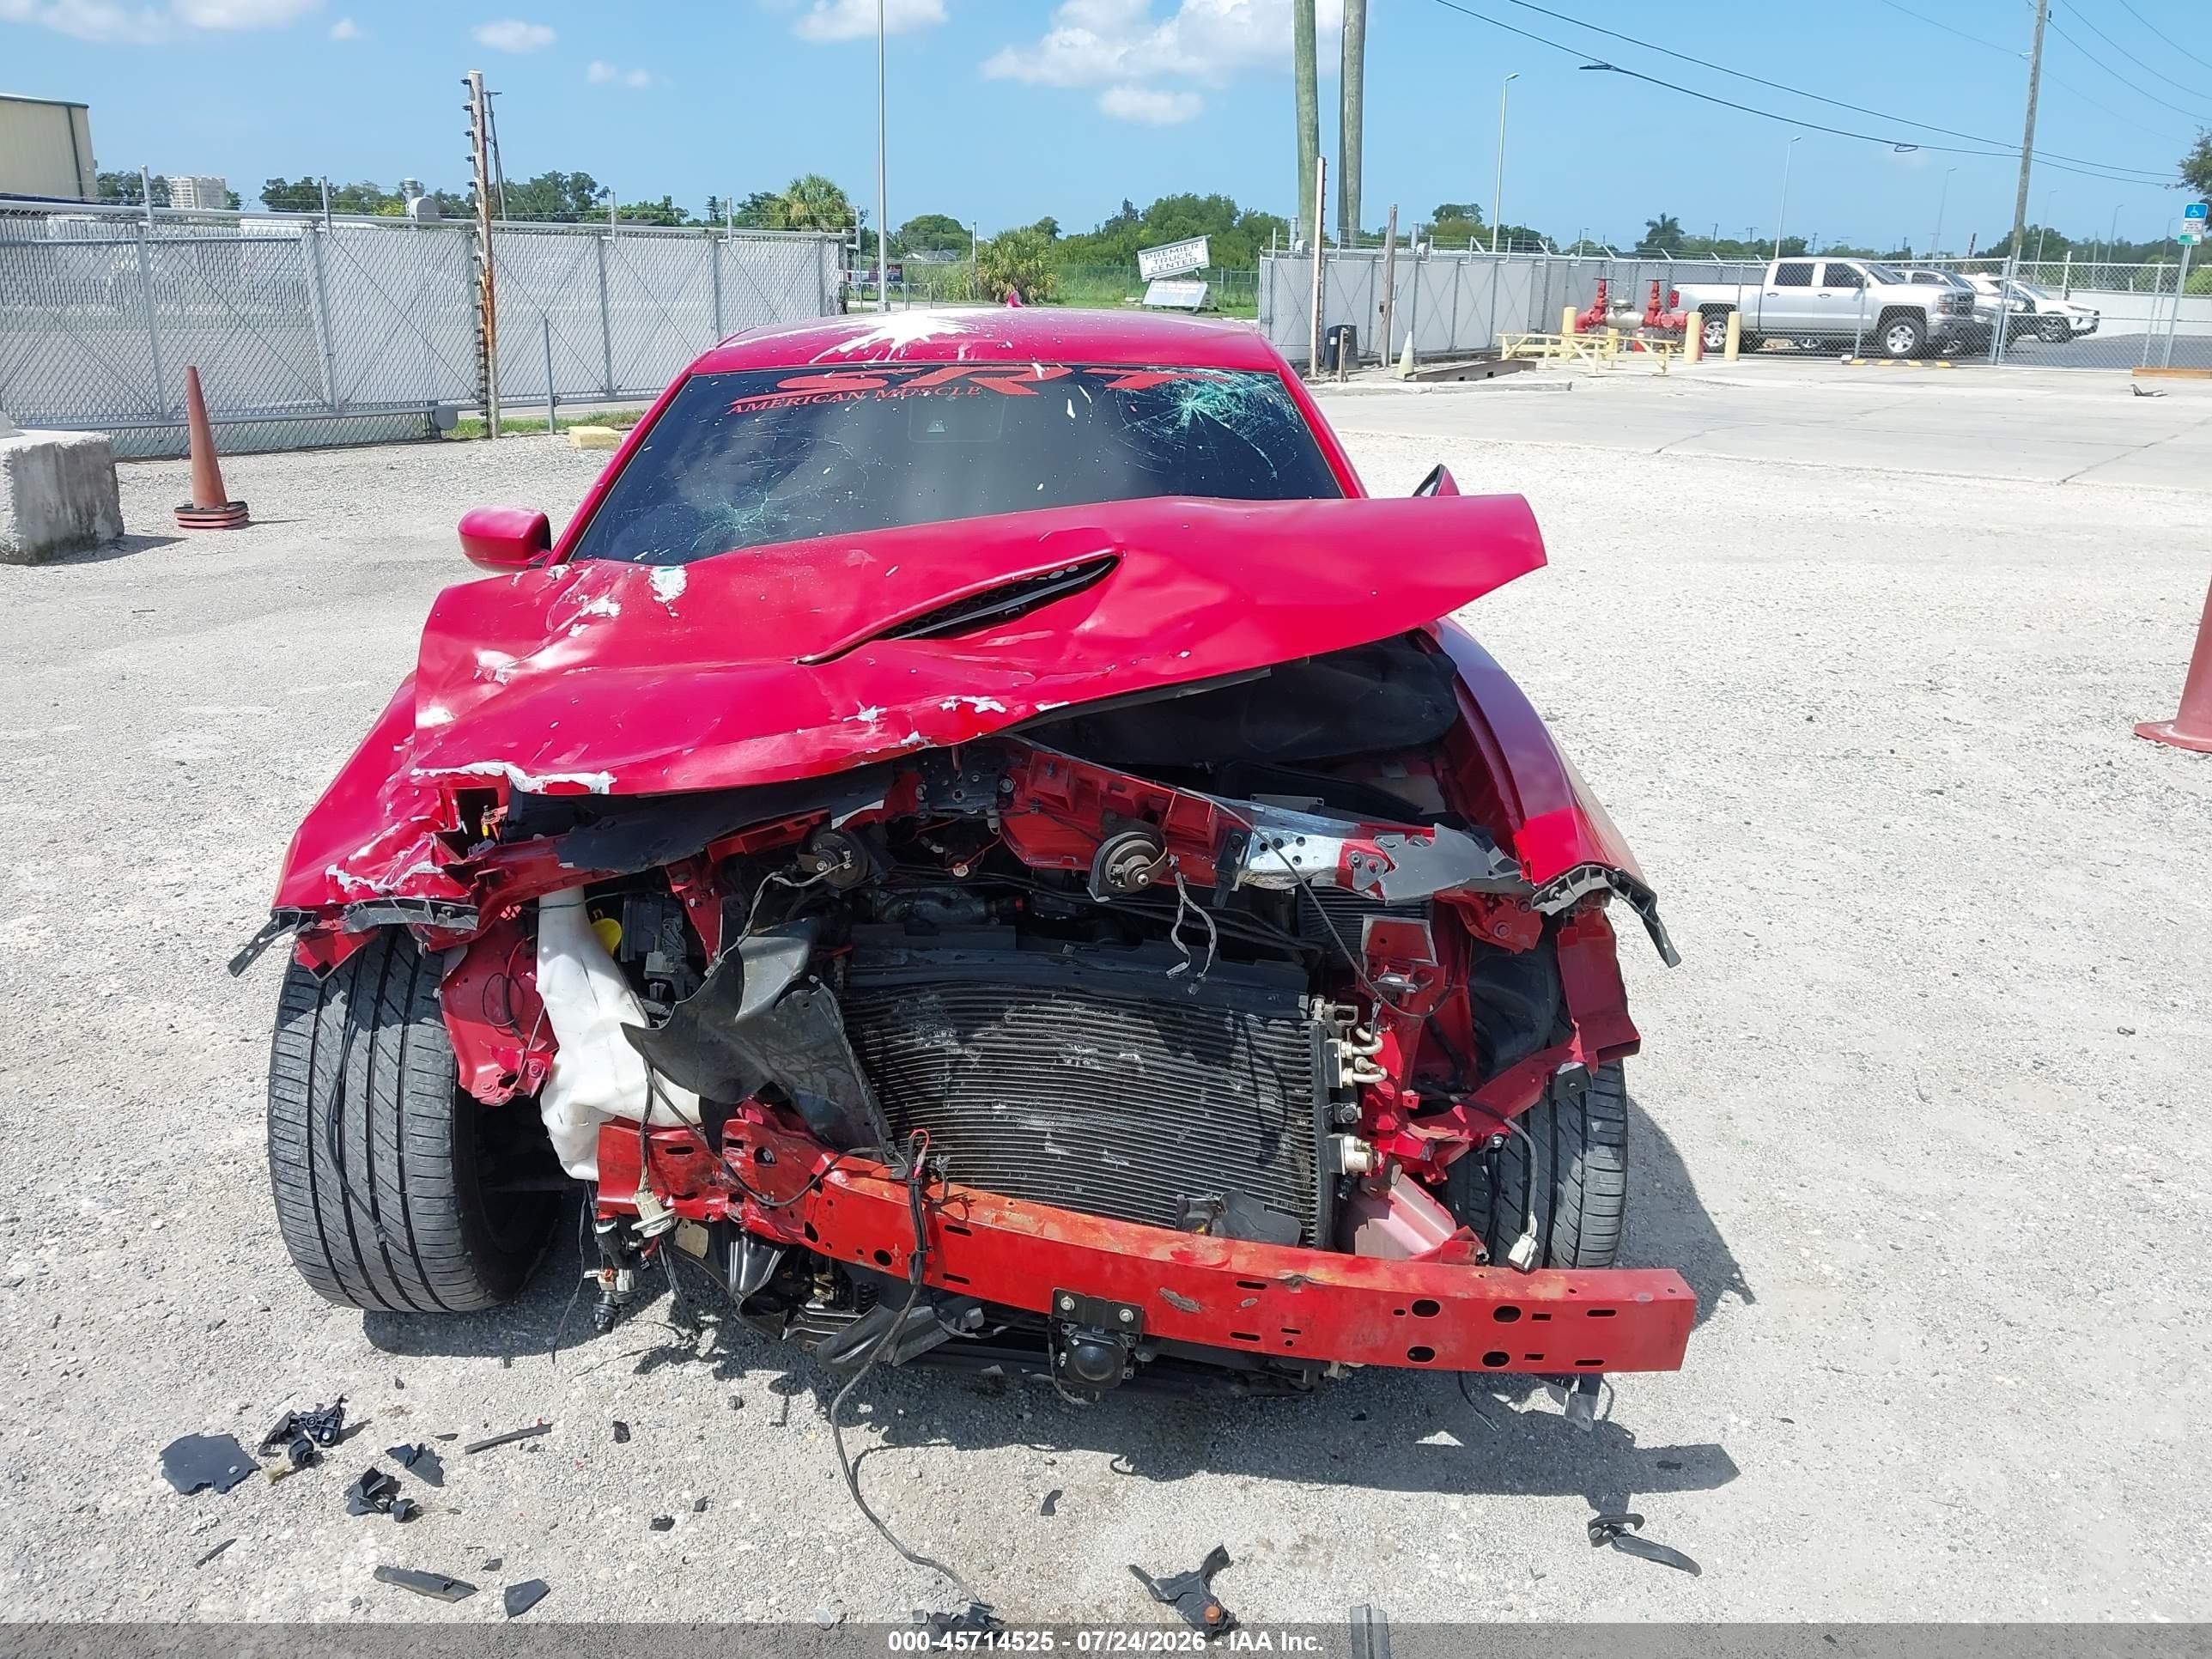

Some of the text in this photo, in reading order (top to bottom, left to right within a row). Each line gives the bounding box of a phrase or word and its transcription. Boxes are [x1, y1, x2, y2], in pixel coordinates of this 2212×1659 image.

[1146, 243, 1200, 260] PREMIER
[1153, 251, 1193, 265] TRUCK
[1151, 258, 1198, 272] CENTER
[730, 366, 1231, 405] SRT
[726, 386, 984, 415] AMERICAN MUSCLE
